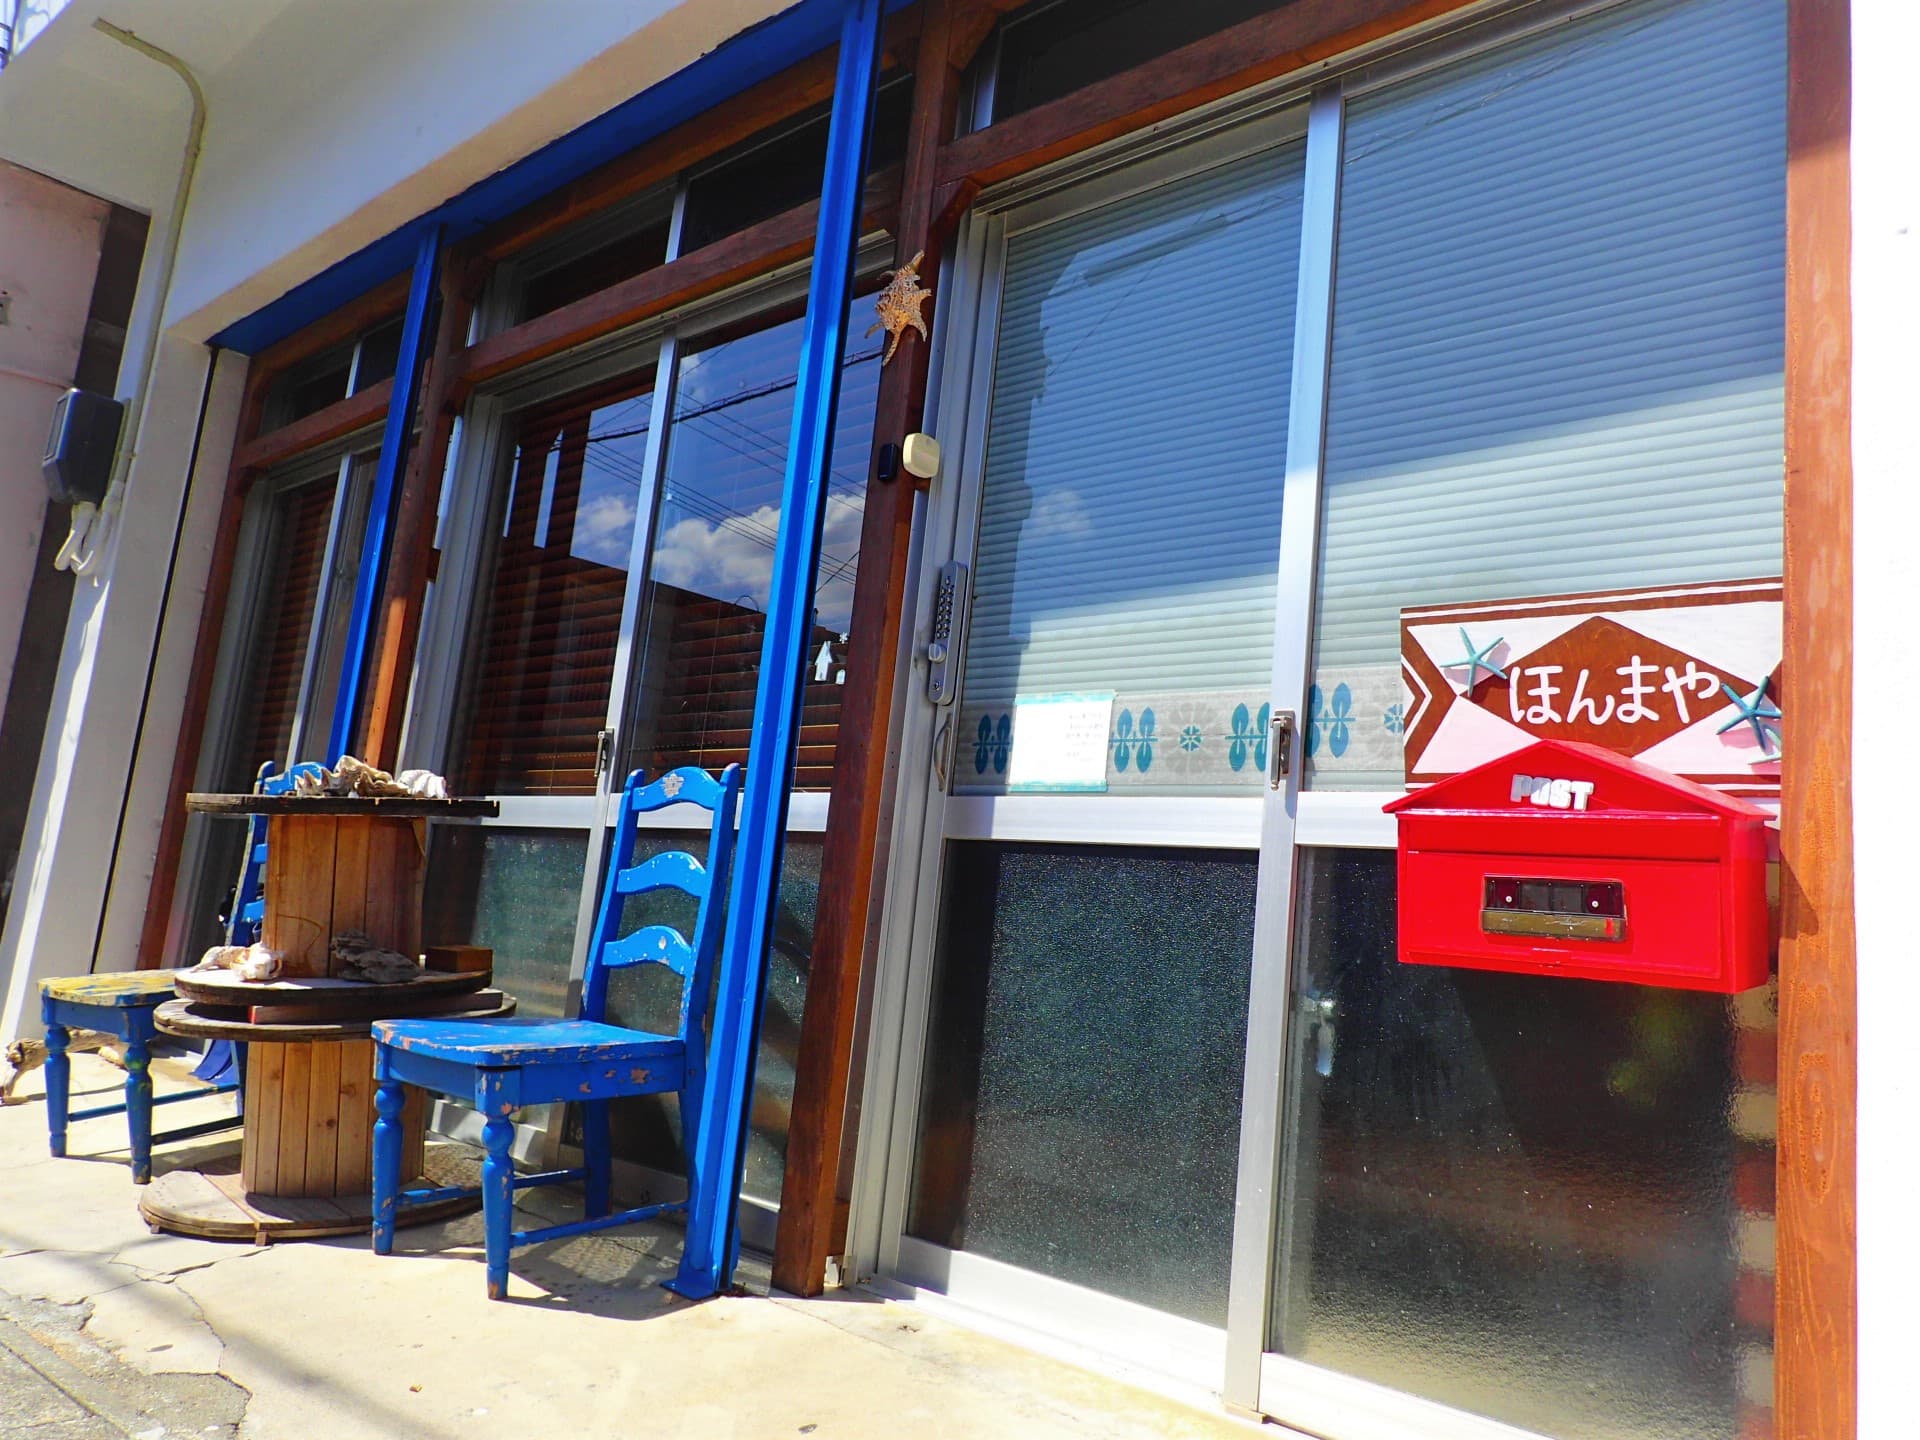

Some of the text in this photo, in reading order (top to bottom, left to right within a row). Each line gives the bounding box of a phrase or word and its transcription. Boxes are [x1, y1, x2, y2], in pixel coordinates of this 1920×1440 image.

[1509, 655, 1720, 725] ほんまや
[1511, 774, 1594, 811] POST
